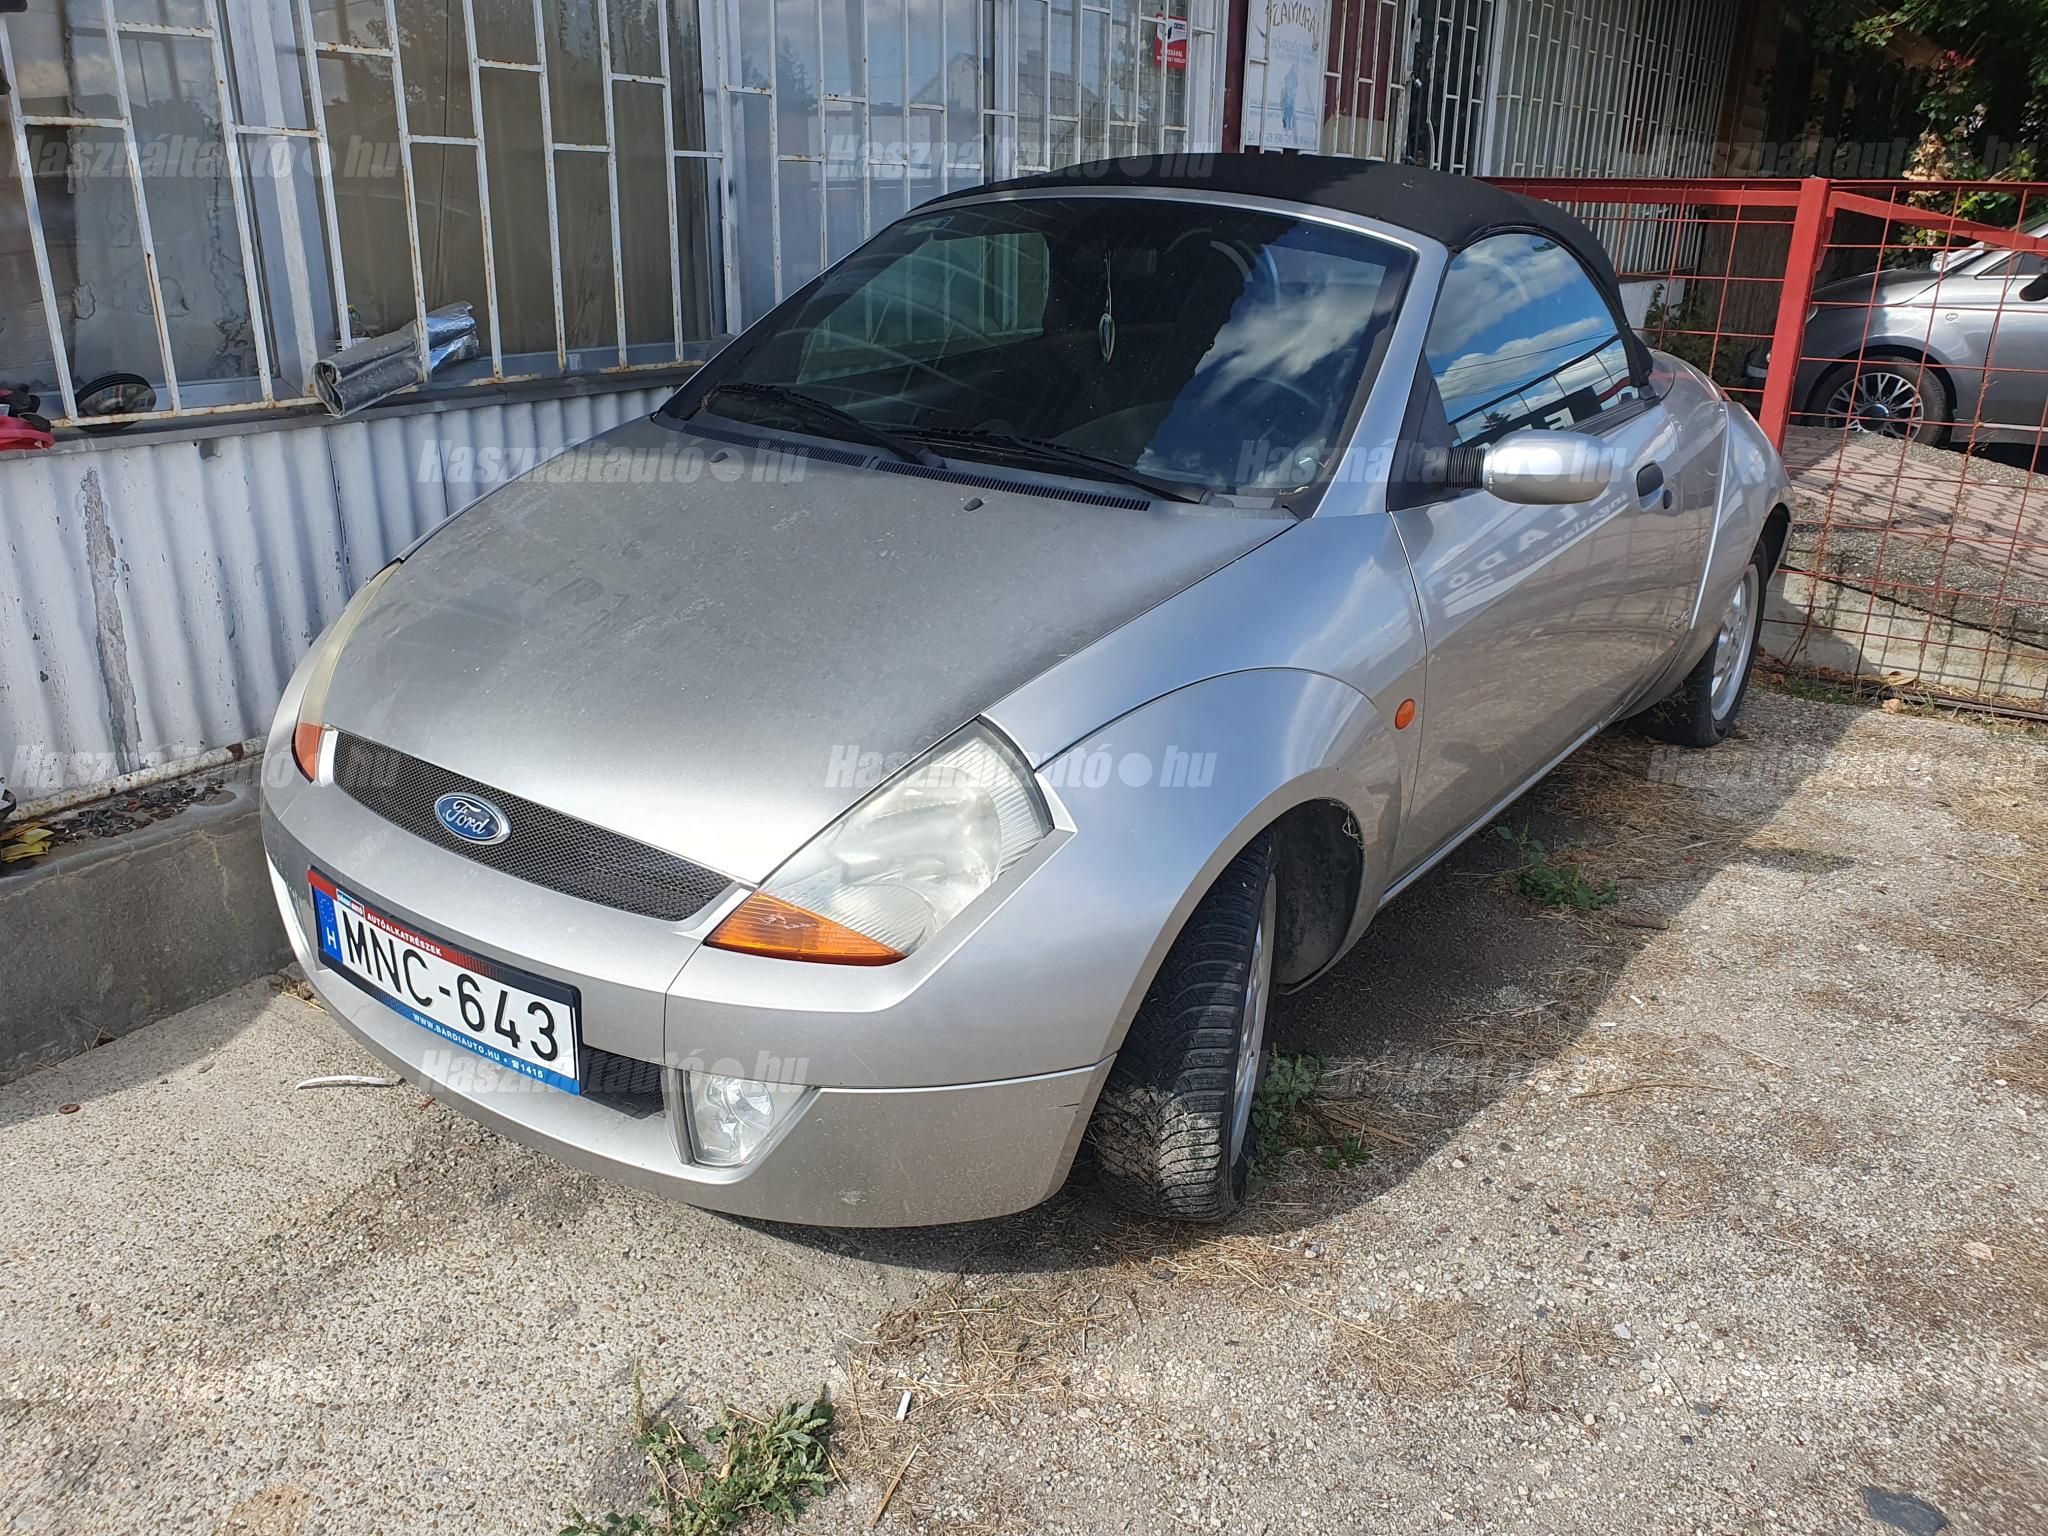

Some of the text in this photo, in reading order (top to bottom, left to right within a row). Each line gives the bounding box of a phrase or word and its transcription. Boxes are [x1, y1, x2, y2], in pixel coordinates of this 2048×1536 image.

[443, 800, 490, 834] Ford
[325, 927, 337, 950] H
[367, 913, 442, 957] AUTÓALKATRÉSZEK
[342, 909, 558, 1062] MNC-643
[413, 1013, 500, 1061] WWW.BARDIAUTO.HU
